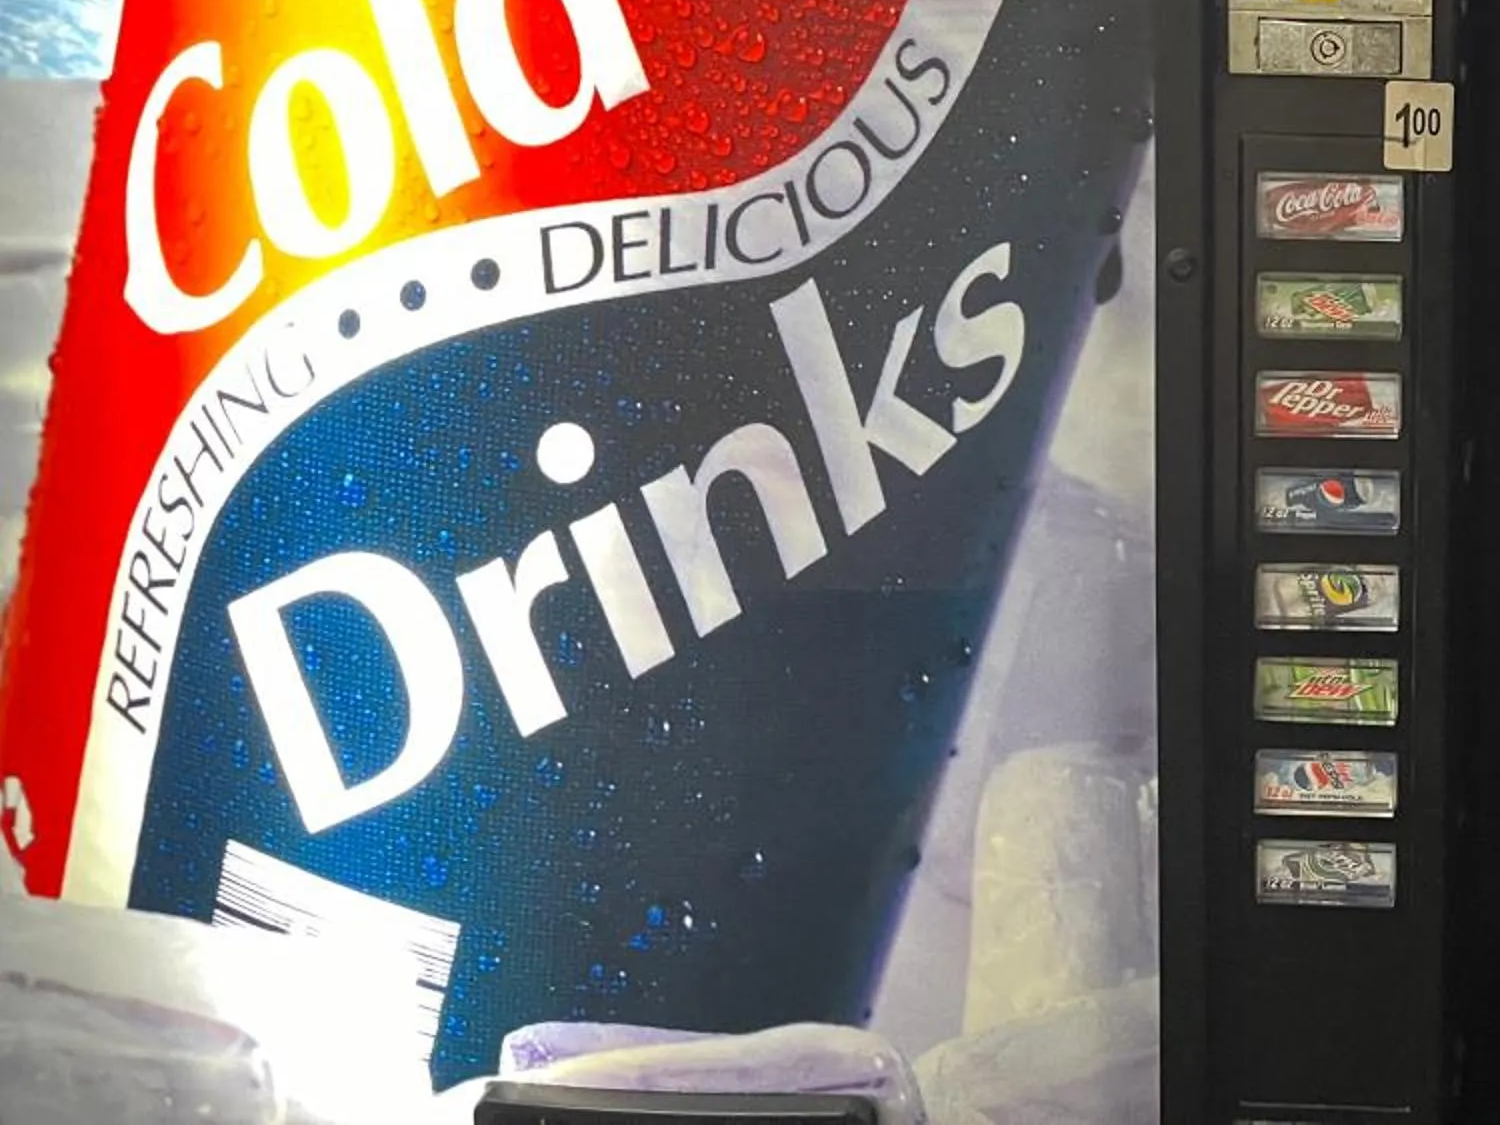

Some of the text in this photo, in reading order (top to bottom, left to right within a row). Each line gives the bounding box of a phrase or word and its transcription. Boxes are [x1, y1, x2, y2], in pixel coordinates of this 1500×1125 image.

[105, 36, 954, 737] REFRESHING DELICIOUS
[227, 241, 1026, 836] Drinks
[1269, 381, 1364, 418] Pepper
[1304, 380, 1343, 399] Dr
